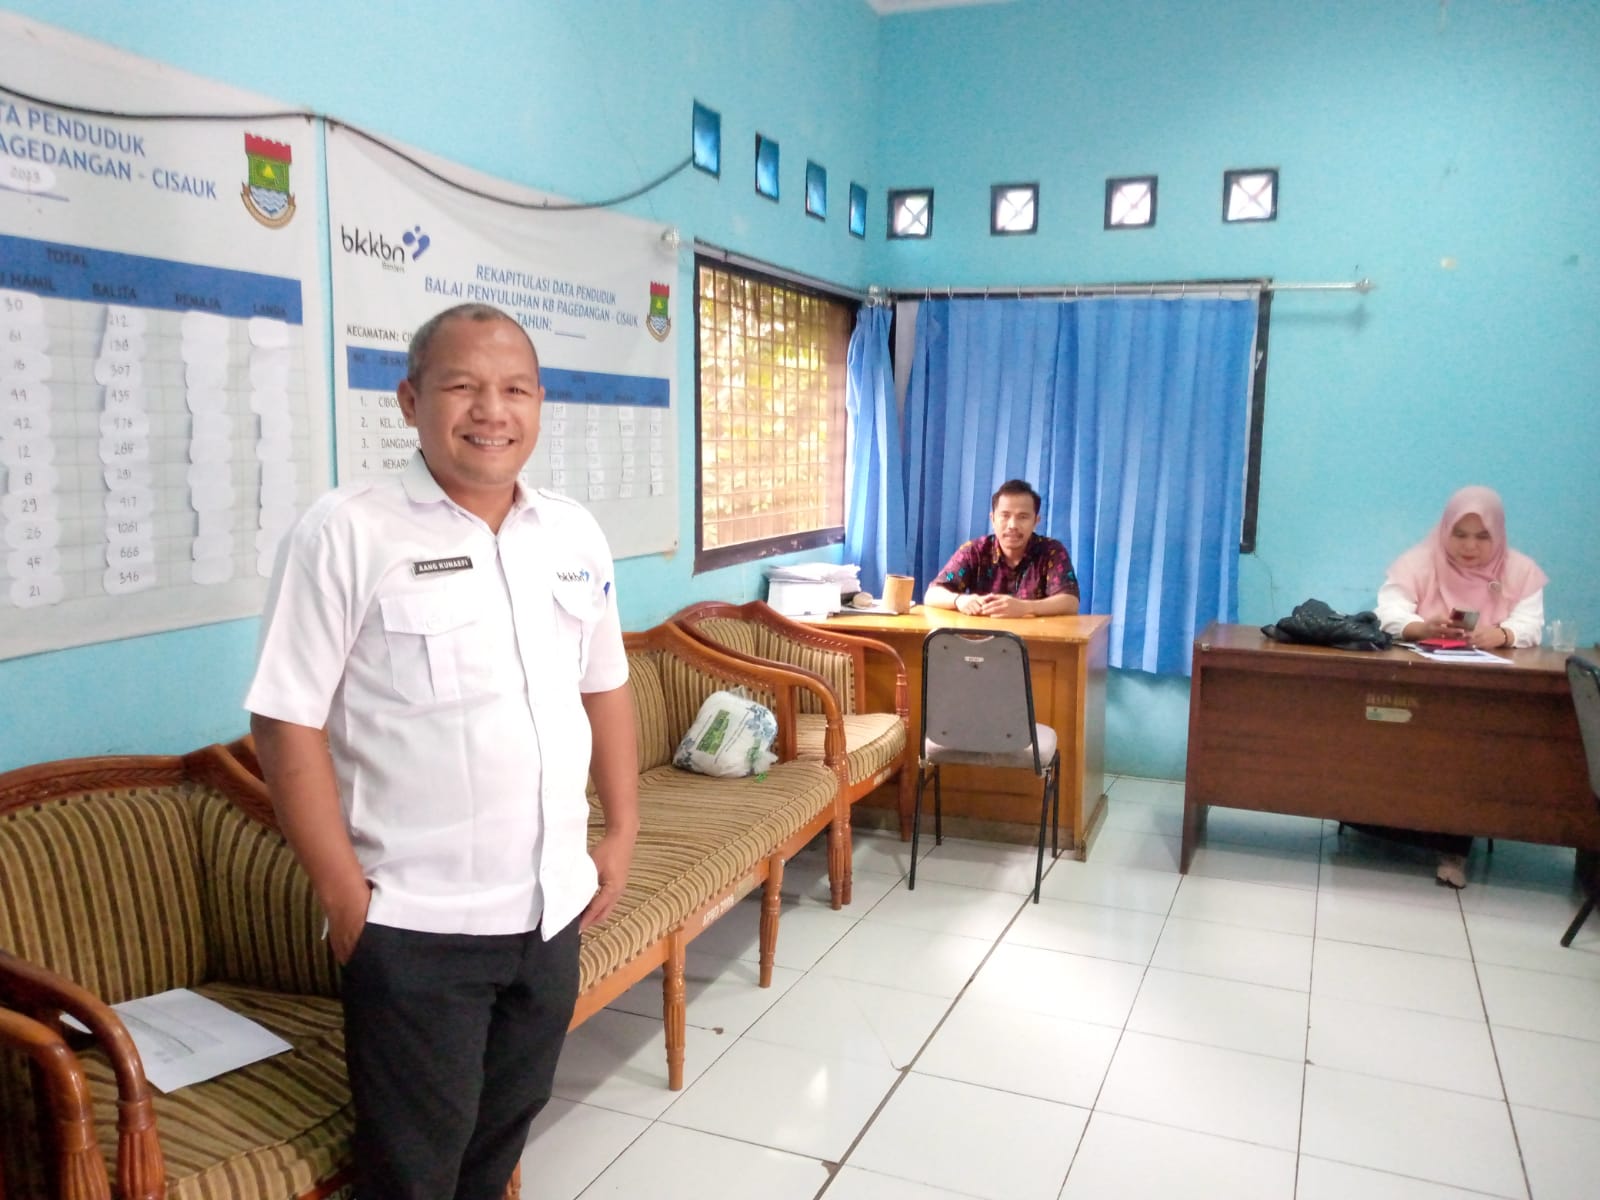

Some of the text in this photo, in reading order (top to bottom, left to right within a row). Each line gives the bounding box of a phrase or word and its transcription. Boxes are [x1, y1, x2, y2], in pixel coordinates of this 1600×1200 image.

[28, 107, 146, 158] PENDUDUK
[152, 167, 217, 201] CISAUK
[341, 224, 405, 264] bkkbn
[92, 282, 137, 299] BALITA
[425, 276, 463, 298] BALAI
[467, 283, 540, 311] PENYULUHAN
[542, 297, 555, 313] KB
[557, 300, 610, 322] PAGEDANGAN
[476, 263, 617, 306] REKAPITULASI DATA PENDUDUK
[346, 325, 399, 341] KECAMATAN:
